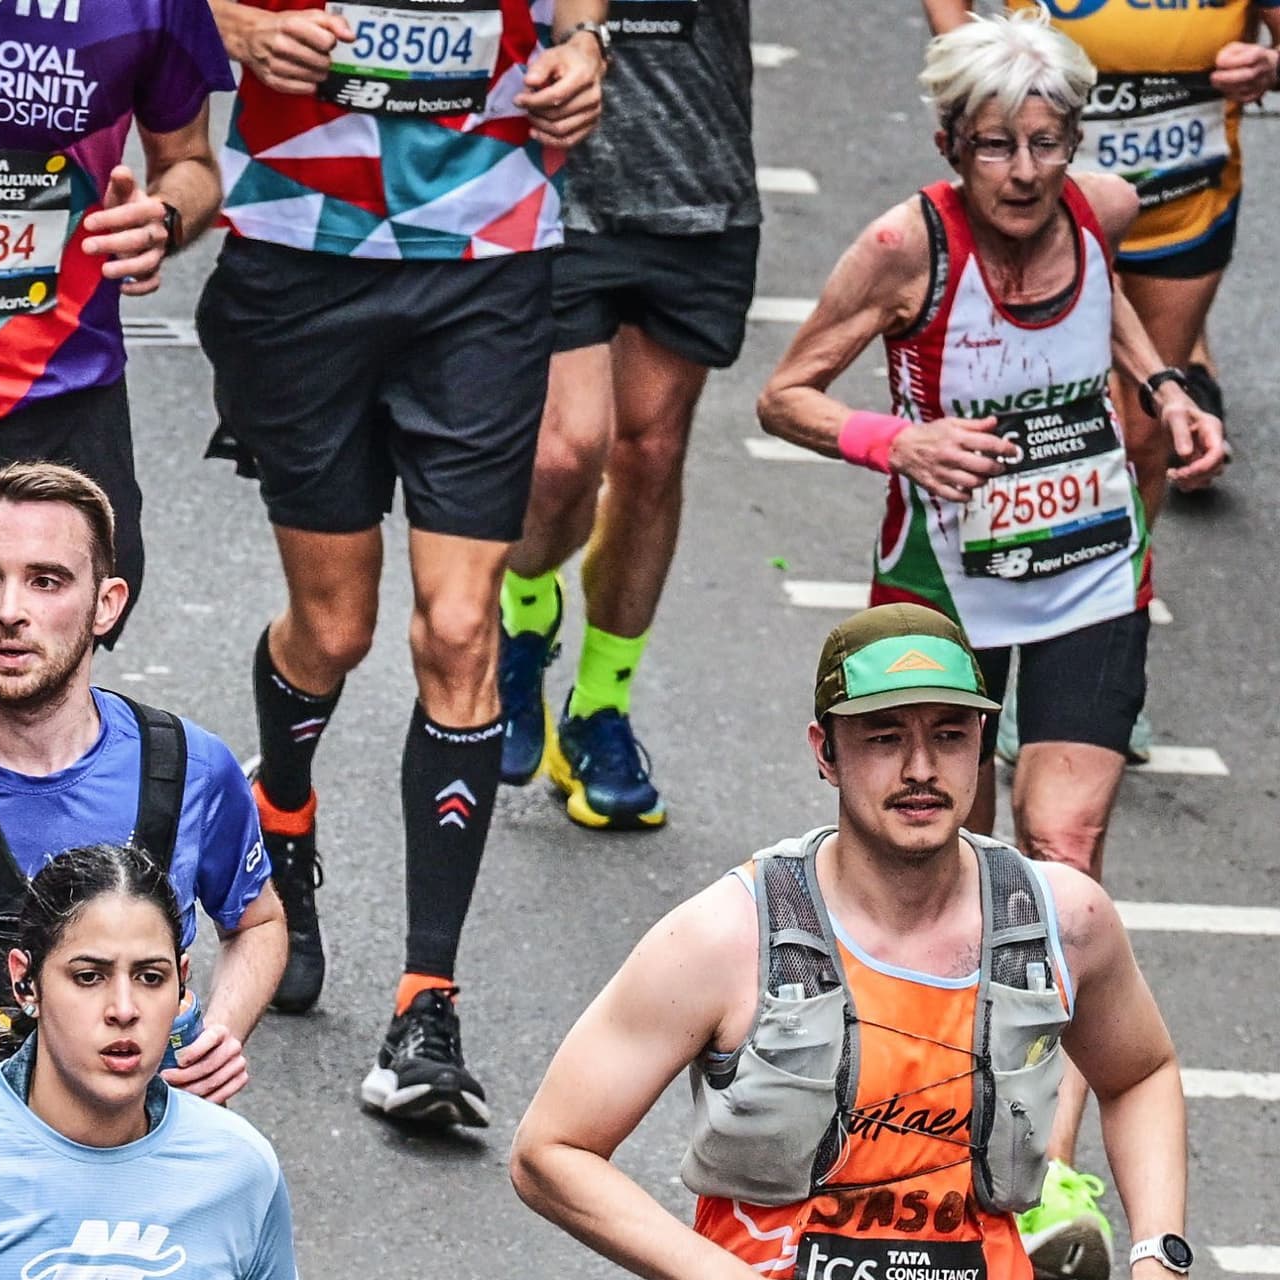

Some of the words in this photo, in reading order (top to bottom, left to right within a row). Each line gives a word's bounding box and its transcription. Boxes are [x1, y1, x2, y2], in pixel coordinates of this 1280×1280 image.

[352, 20, 473, 65] 58504
[386, 98, 417, 112] new
[418, 96, 473, 113] balance
[1082, 82, 1137, 113] cs
[1097, 119, 1207, 167] 55499
[1024, 413, 1064, 432] TATA
[1026, 416, 1106, 446] CONSULTANCY
[1028, 436, 1088, 461] SERVICES
[988, 468, 1102, 531] 25891
[1032, 556, 1062, 575] new
[1063, 540, 1119, 564] balance
[887, 1250, 931, 1266] TATA
